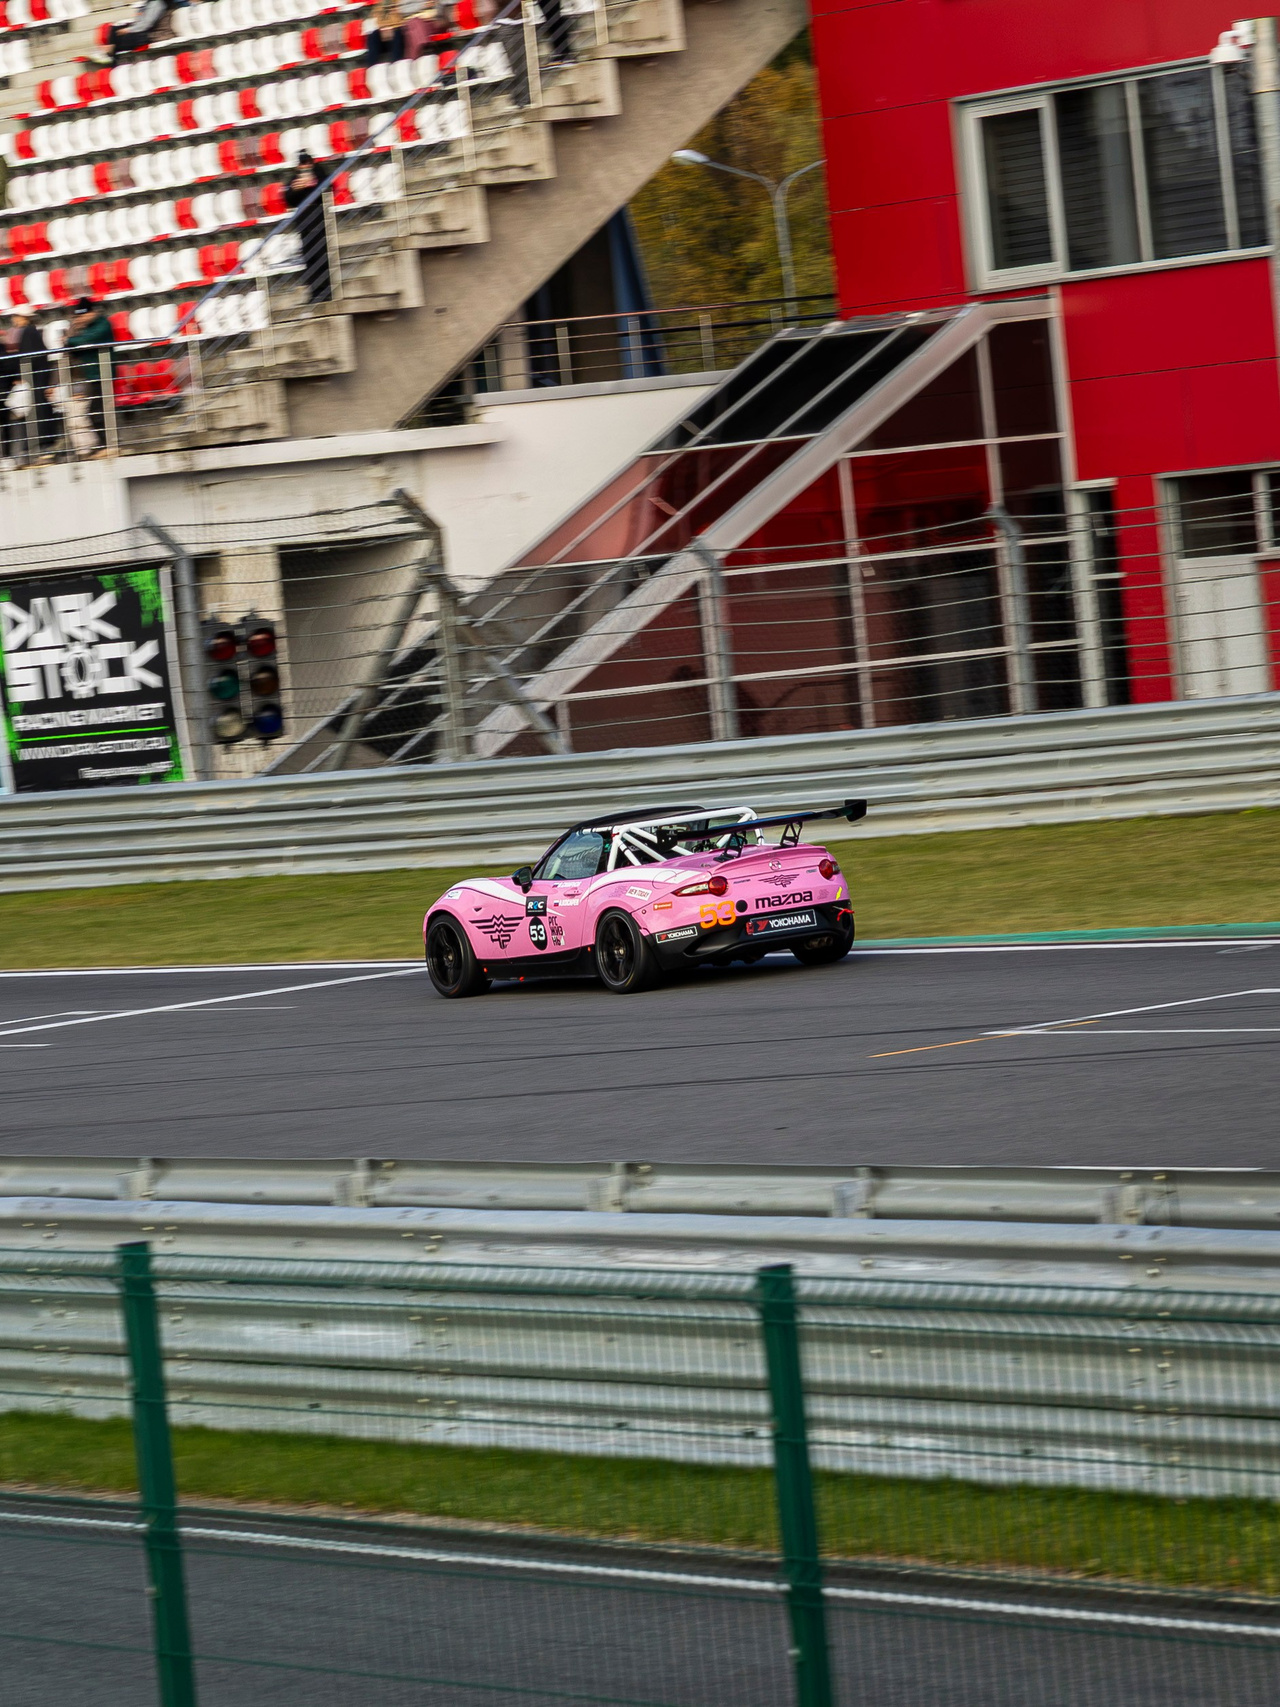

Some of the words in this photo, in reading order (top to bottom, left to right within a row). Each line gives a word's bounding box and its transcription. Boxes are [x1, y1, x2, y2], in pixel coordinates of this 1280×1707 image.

[5, 640, 163, 703] STOCK
[699, 900, 737, 929] 53
[769, 914, 812, 928] YOKOHAMA
[530, 925, 546, 941] 53
[667, 929, 693, 939] YOKOHAMA
